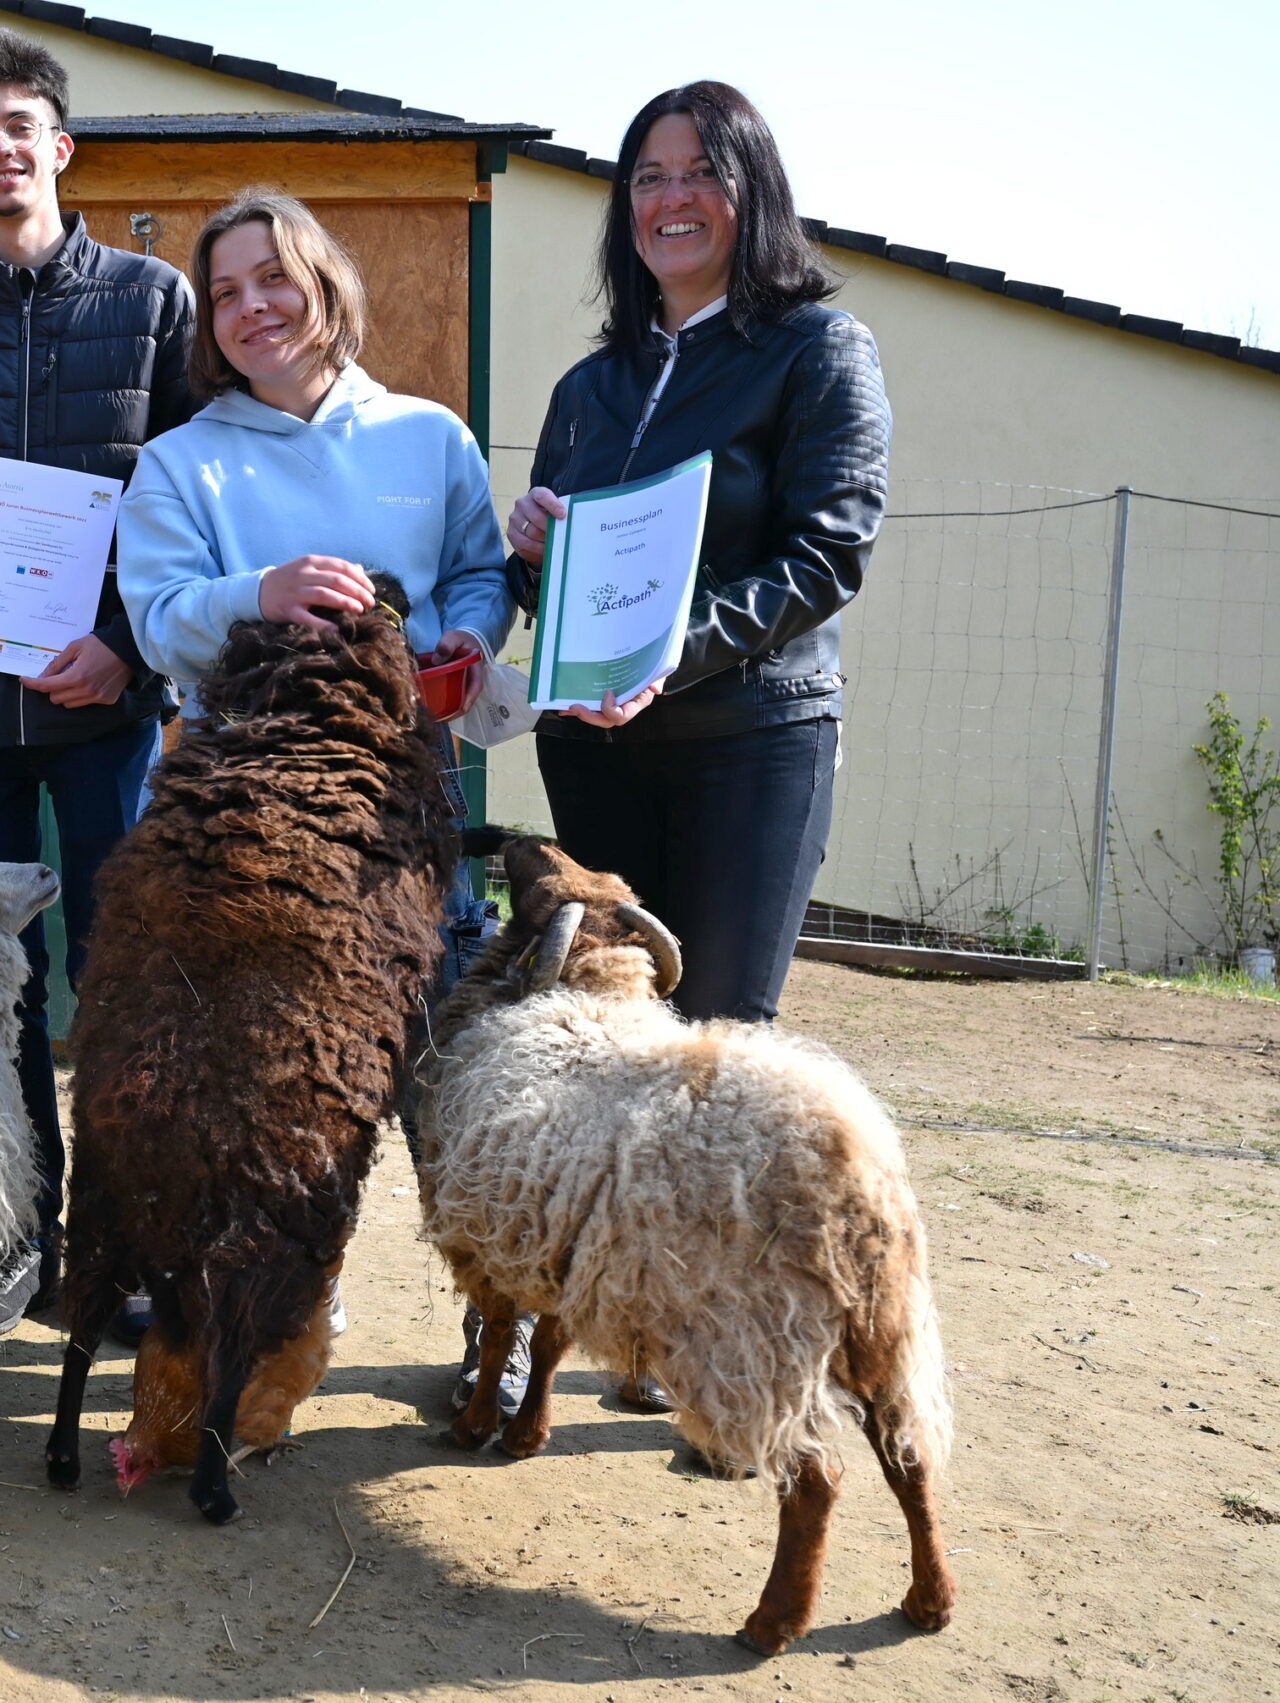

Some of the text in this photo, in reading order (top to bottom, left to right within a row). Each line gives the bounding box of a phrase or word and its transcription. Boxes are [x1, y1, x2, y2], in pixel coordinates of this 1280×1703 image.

[377, 496, 432, 505] FIGHT FOR IT
[600, 508, 663, 531] Businessplan
[615, 542, 646, 556] Actipath
[601, 591, 651, 612] Actipath
